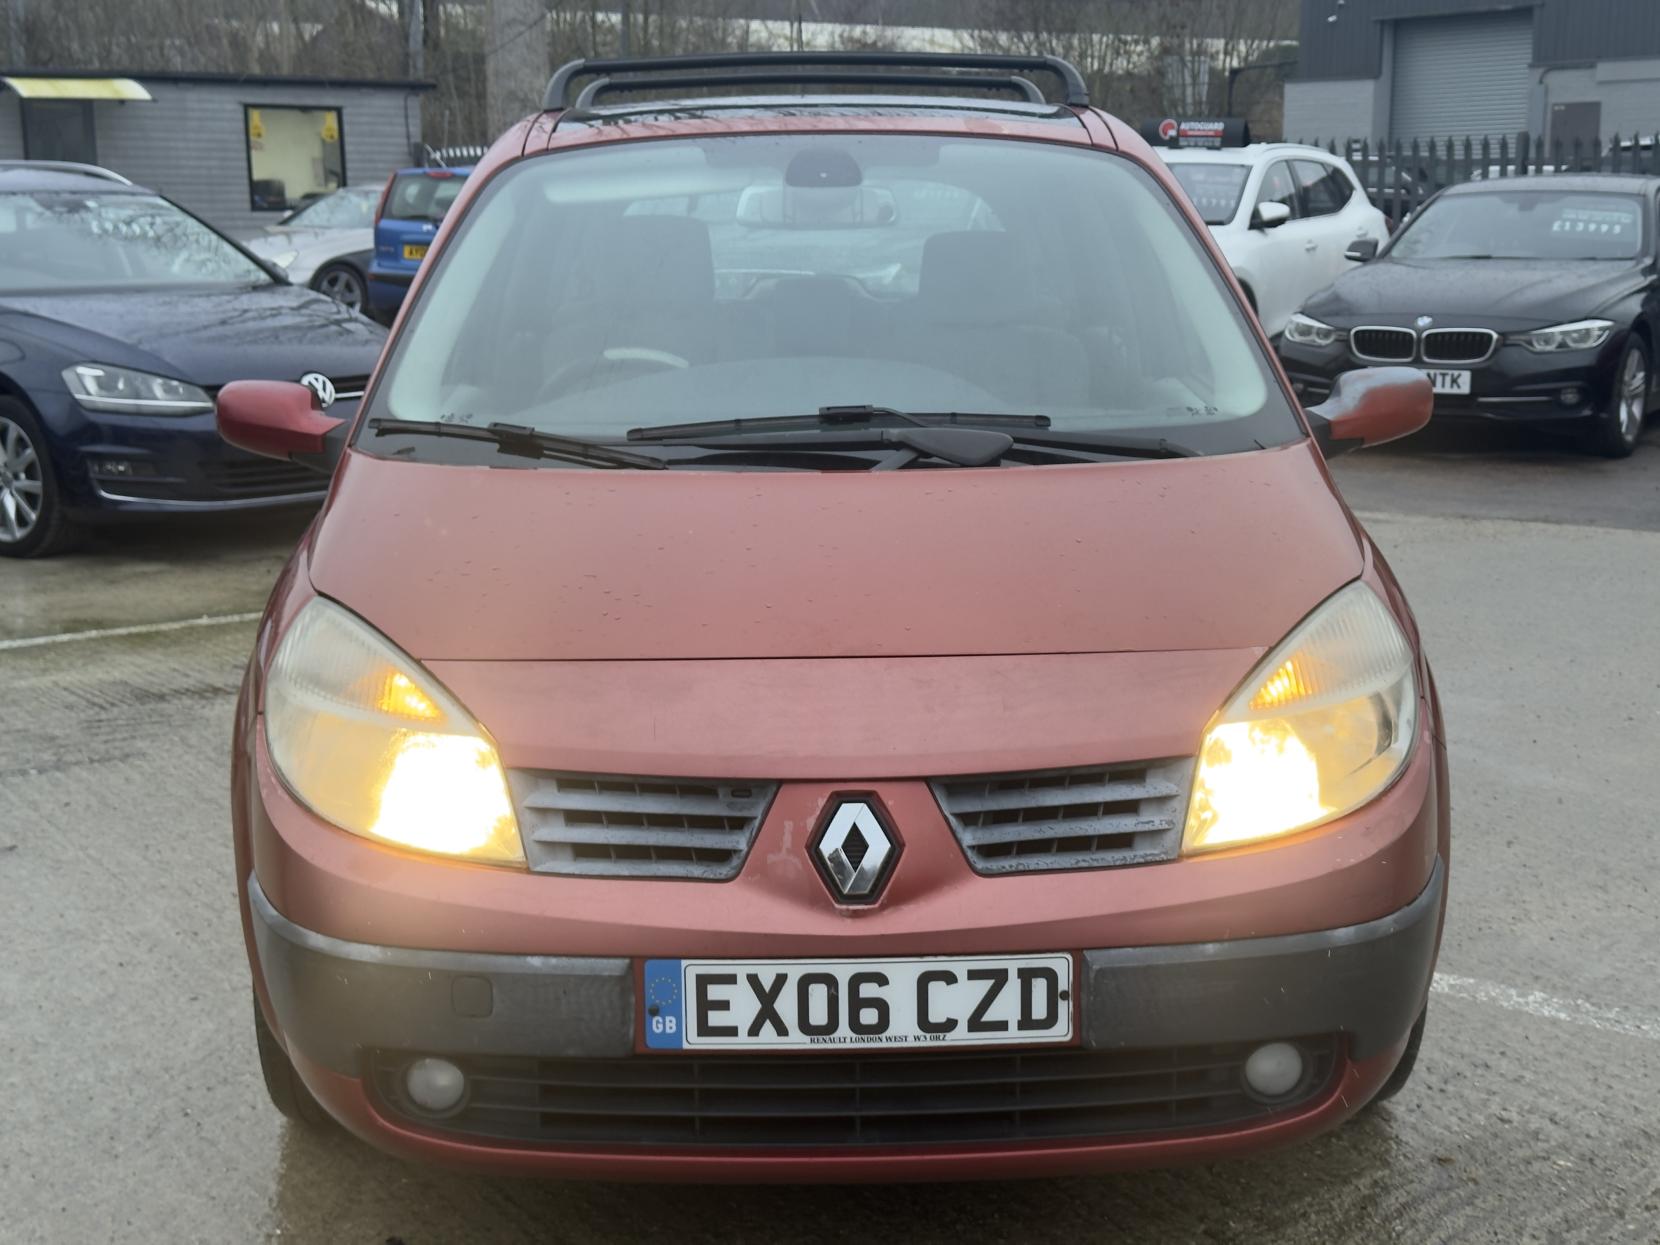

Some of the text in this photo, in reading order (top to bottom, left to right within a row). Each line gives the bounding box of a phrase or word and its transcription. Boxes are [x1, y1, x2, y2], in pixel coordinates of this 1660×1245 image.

[1179, 121, 1225, 131] AUTOGUARD
[695, 966, 1059, 1037] EX06 CZD
[652, 1015, 677, 1034] GB
[809, 1036, 847, 1044] RENAULT
[849, 1035, 882, 1043] LONDON
[885, 1035, 908, 1043] WEST
